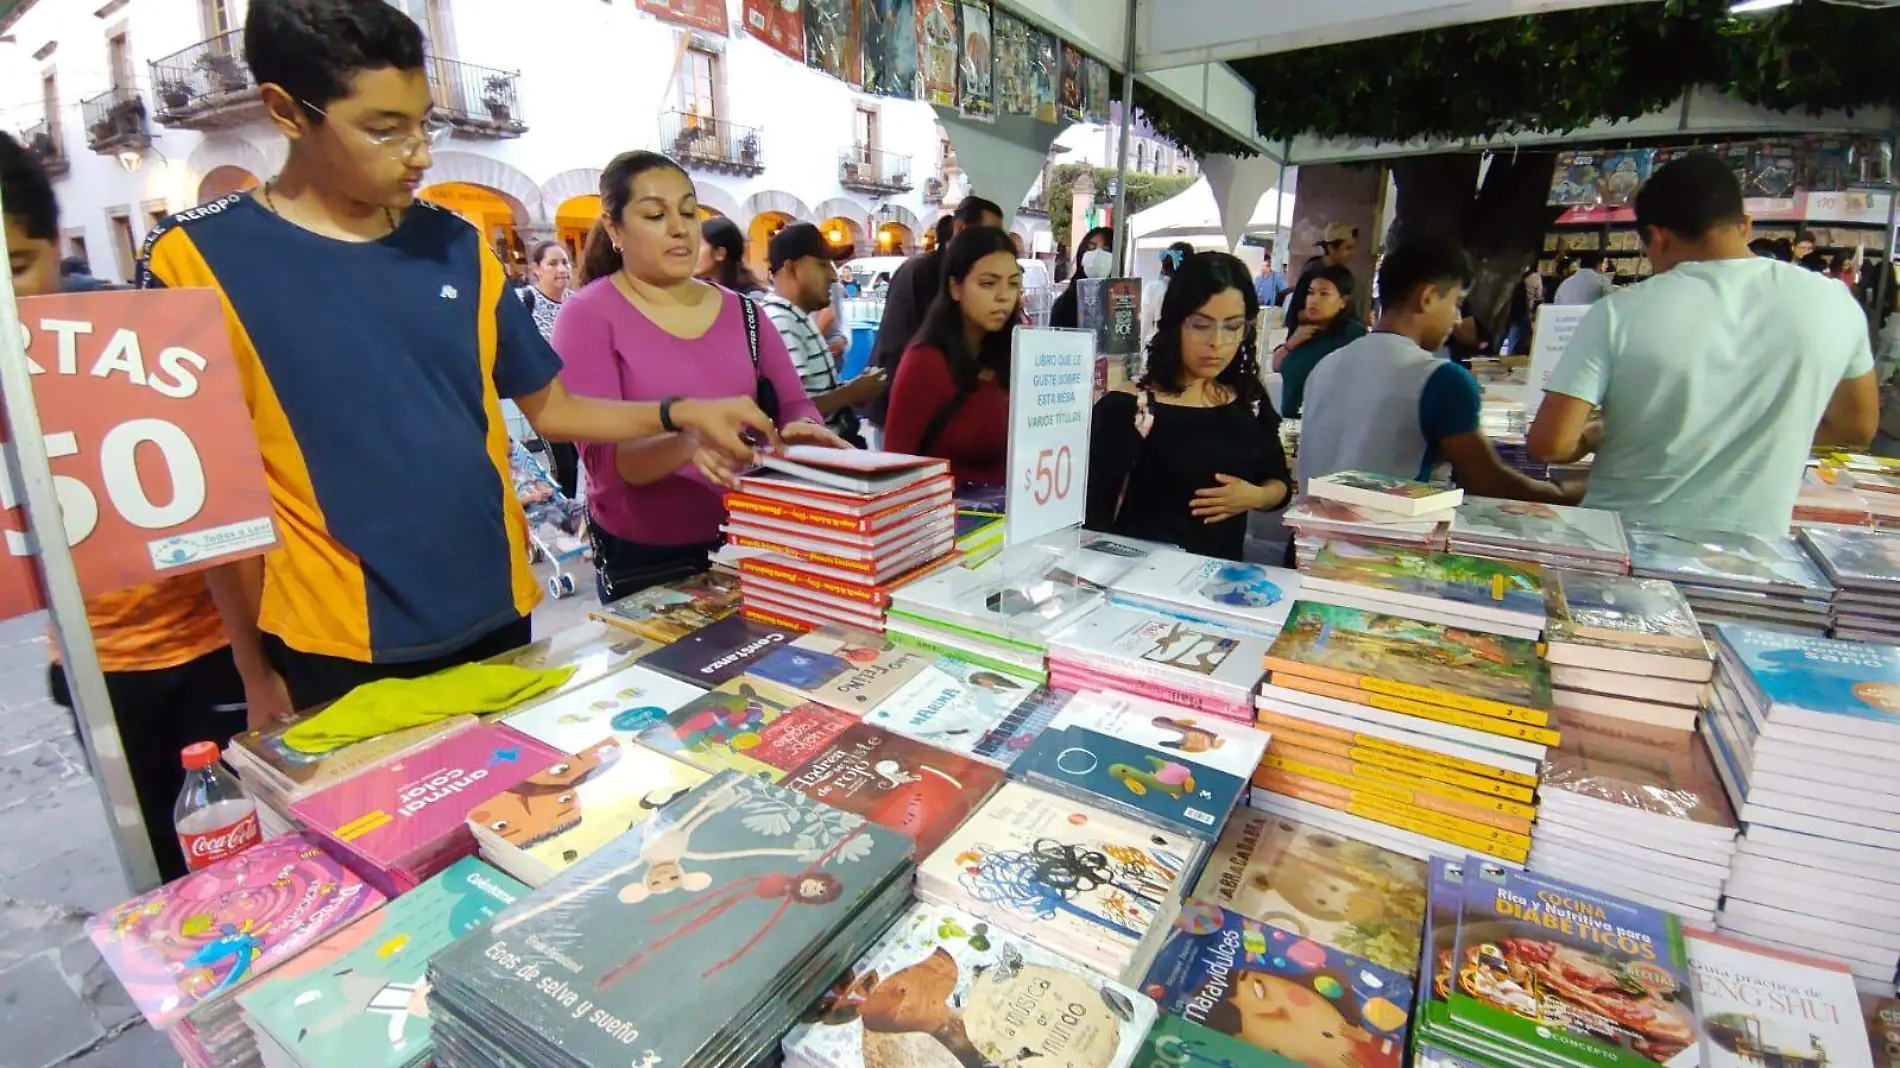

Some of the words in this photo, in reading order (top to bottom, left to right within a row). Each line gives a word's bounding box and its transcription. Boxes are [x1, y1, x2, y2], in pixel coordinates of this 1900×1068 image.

[1034, 354, 1056, 367] LIBRO
[1058, 354, 1072, 366] QUE
[1033, 374, 1057, 387] GUSTE
[1027, 414, 1053, 428] VARIOS
[699, 633, 785, 674] Constanza
[400, 768, 465, 802] color
[785, 749, 847, 796] Andrea
[833, 759, 876, 791] rojo
[398, 769, 489, 818] animal
[192, 814, 257, 857] Coca-Cola
[1497, 888, 1528, 905] Rica
[1531, 900, 1541, 912] y
[1545, 902, 1612, 931] Nutritiva
[1616, 926, 1652, 943] para
[1537, 890, 1607, 920] COCINA
[485, 941, 521, 970] Ecos
[516, 962, 540, 982] de
[536, 974, 580, 1008] selva
[571, 1001, 593, 1019] y
[589, 1010, 639, 1044] sueño
[1768, 989, 1841, 1025] SHUI
[1552, 1033, 1618, 1062] CONCEPTO
